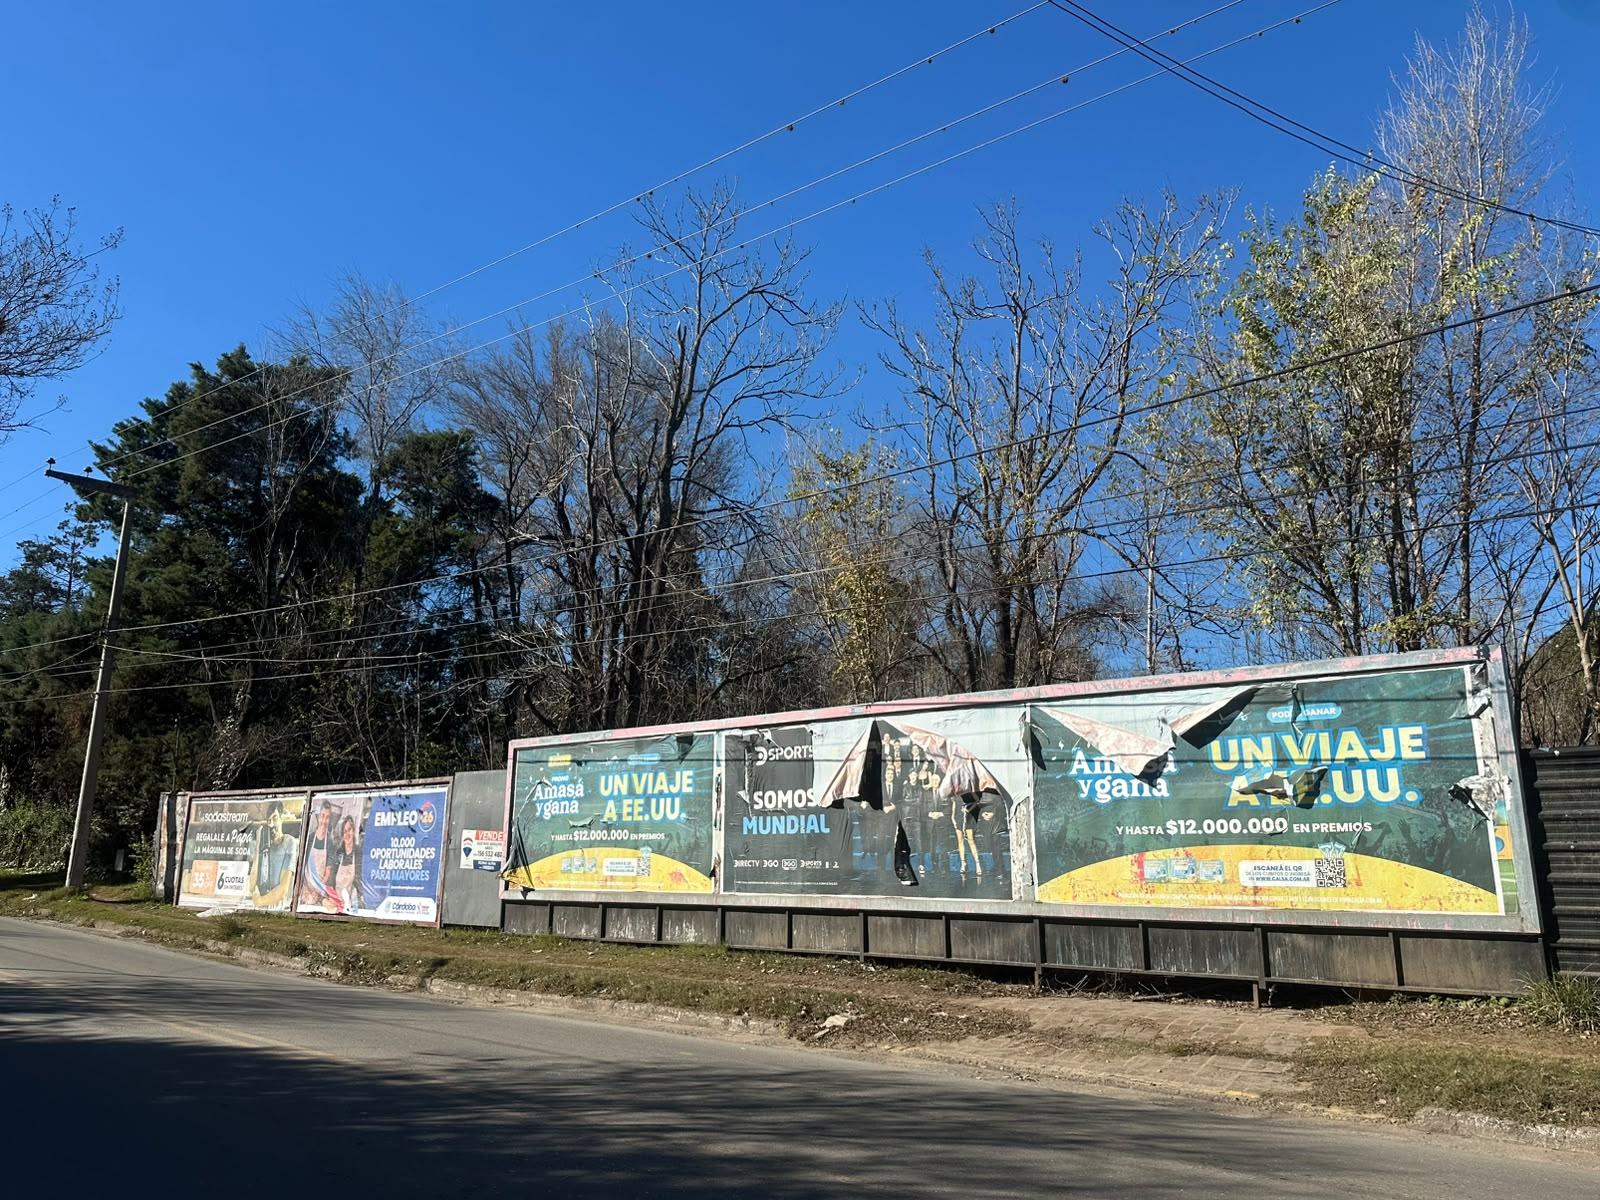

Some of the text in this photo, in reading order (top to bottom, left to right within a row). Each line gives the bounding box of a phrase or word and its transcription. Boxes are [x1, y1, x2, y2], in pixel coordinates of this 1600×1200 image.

[1212, 726, 1426, 770] UN VIAJE
[533, 778, 584, 800] Amasá
[600, 770, 693, 796] UN VIAJE
[1228, 767, 1418, 806] A .UU.
[753, 788, 817, 810] SOMOS
[204, 811, 248, 822] sodastream
[603, 797, 686, 822] A EE.UU.
[374, 810, 418, 826] EMPLEO
[742, 814, 830, 834] MUNDIAL
[574, 829, 629, 841] $12.000.000
[1116, 818, 1372, 836] Y HASTA $12.000.000 EN PREMIOS
[196, 833, 225, 842] REGALALE
[391, 837, 415, 848] 10.000
[479, 831, 504, 840] VENDE
[370, 848, 436, 859] OPORTUNIDADES
[379, 859, 423, 870] LABORALES
[218, 872, 224, 889] 6
[370, 870, 430, 880] PARA MAYORES
